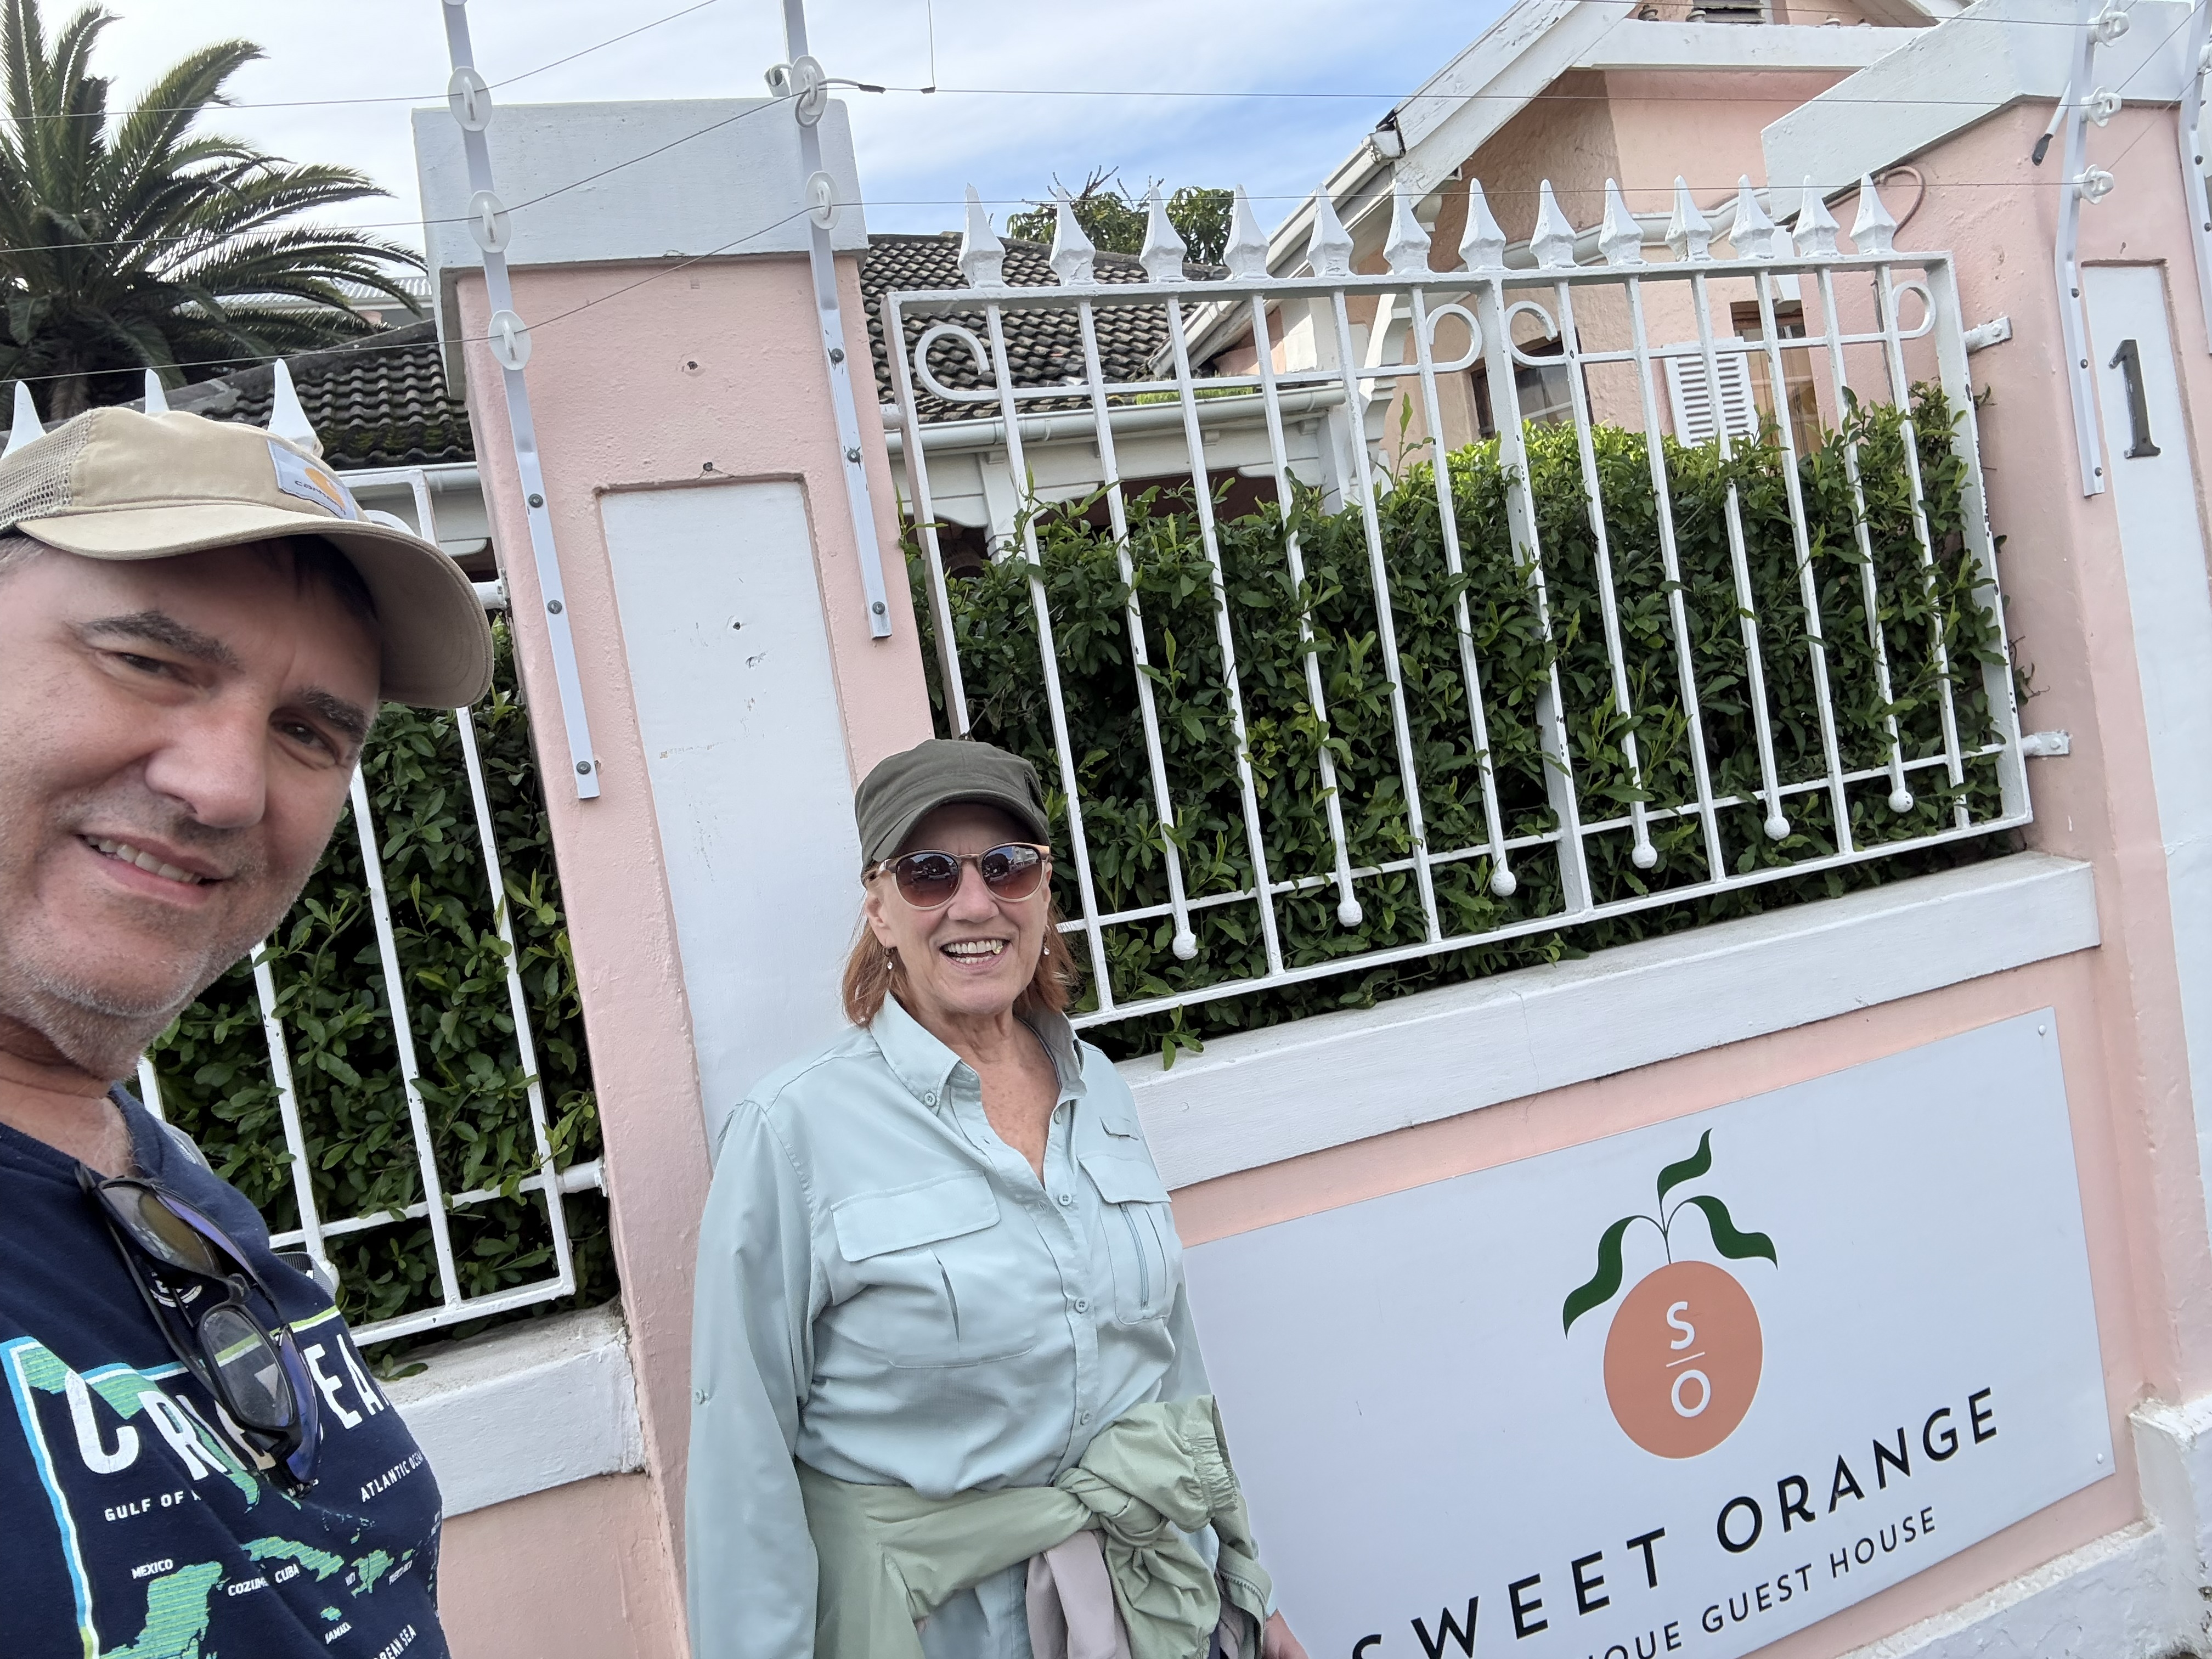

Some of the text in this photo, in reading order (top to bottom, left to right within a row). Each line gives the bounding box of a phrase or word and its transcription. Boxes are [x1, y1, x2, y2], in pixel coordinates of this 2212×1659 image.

[2108, 339, 2162, 459] 1
[1666, 1301, 1695, 1350] S
[1671, 1369, 1711, 1418] O
[360, 1460, 410, 1503] ATLANTIC
[1716, 1387, 1997, 1553] ORANGE
[104, 1498, 151, 1521] GULF
[160, 1491, 184, 1508] OF
[131, 1558, 174, 1579] MEXICO
[274, 1564, 300, 1583] CUBA
[1701, 1564, 1812, 1633] GUEST
[1830, 1506, 1936, 1579] HOUSE
[399, 1624, 417, 1646] SEA
